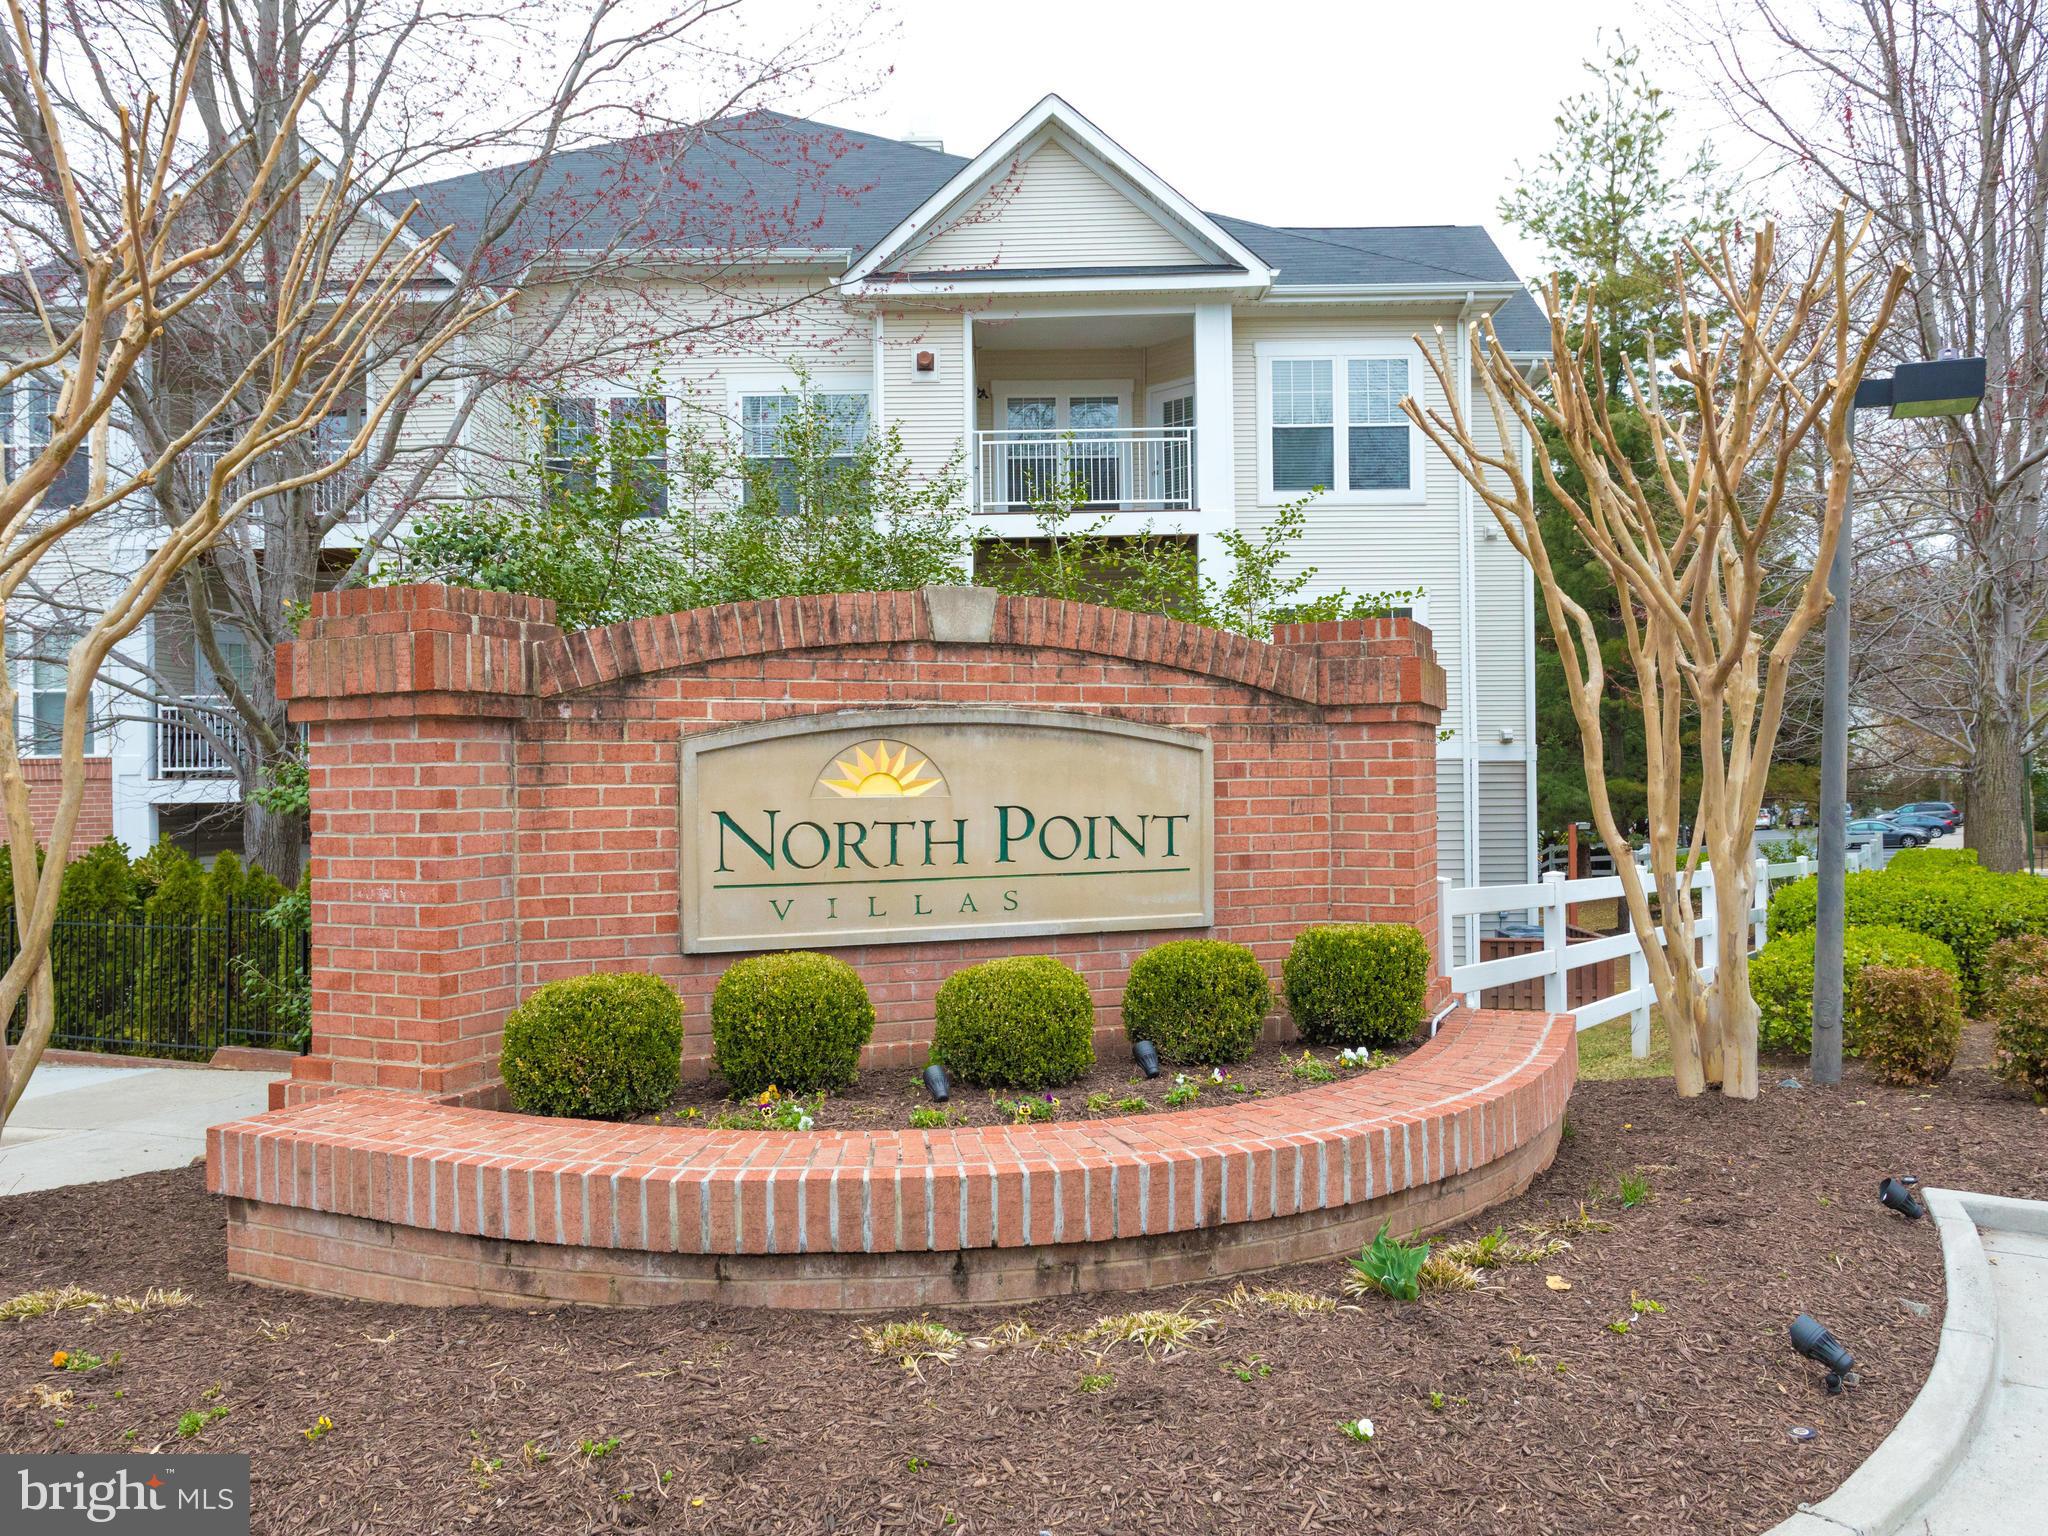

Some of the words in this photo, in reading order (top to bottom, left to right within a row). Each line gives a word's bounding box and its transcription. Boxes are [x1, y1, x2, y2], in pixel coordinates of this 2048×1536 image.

[711, 809, 970, 873] NORTH
[993, 805, 1190, 864] POINT
[768, 890, 1019, 921] VILLAS
